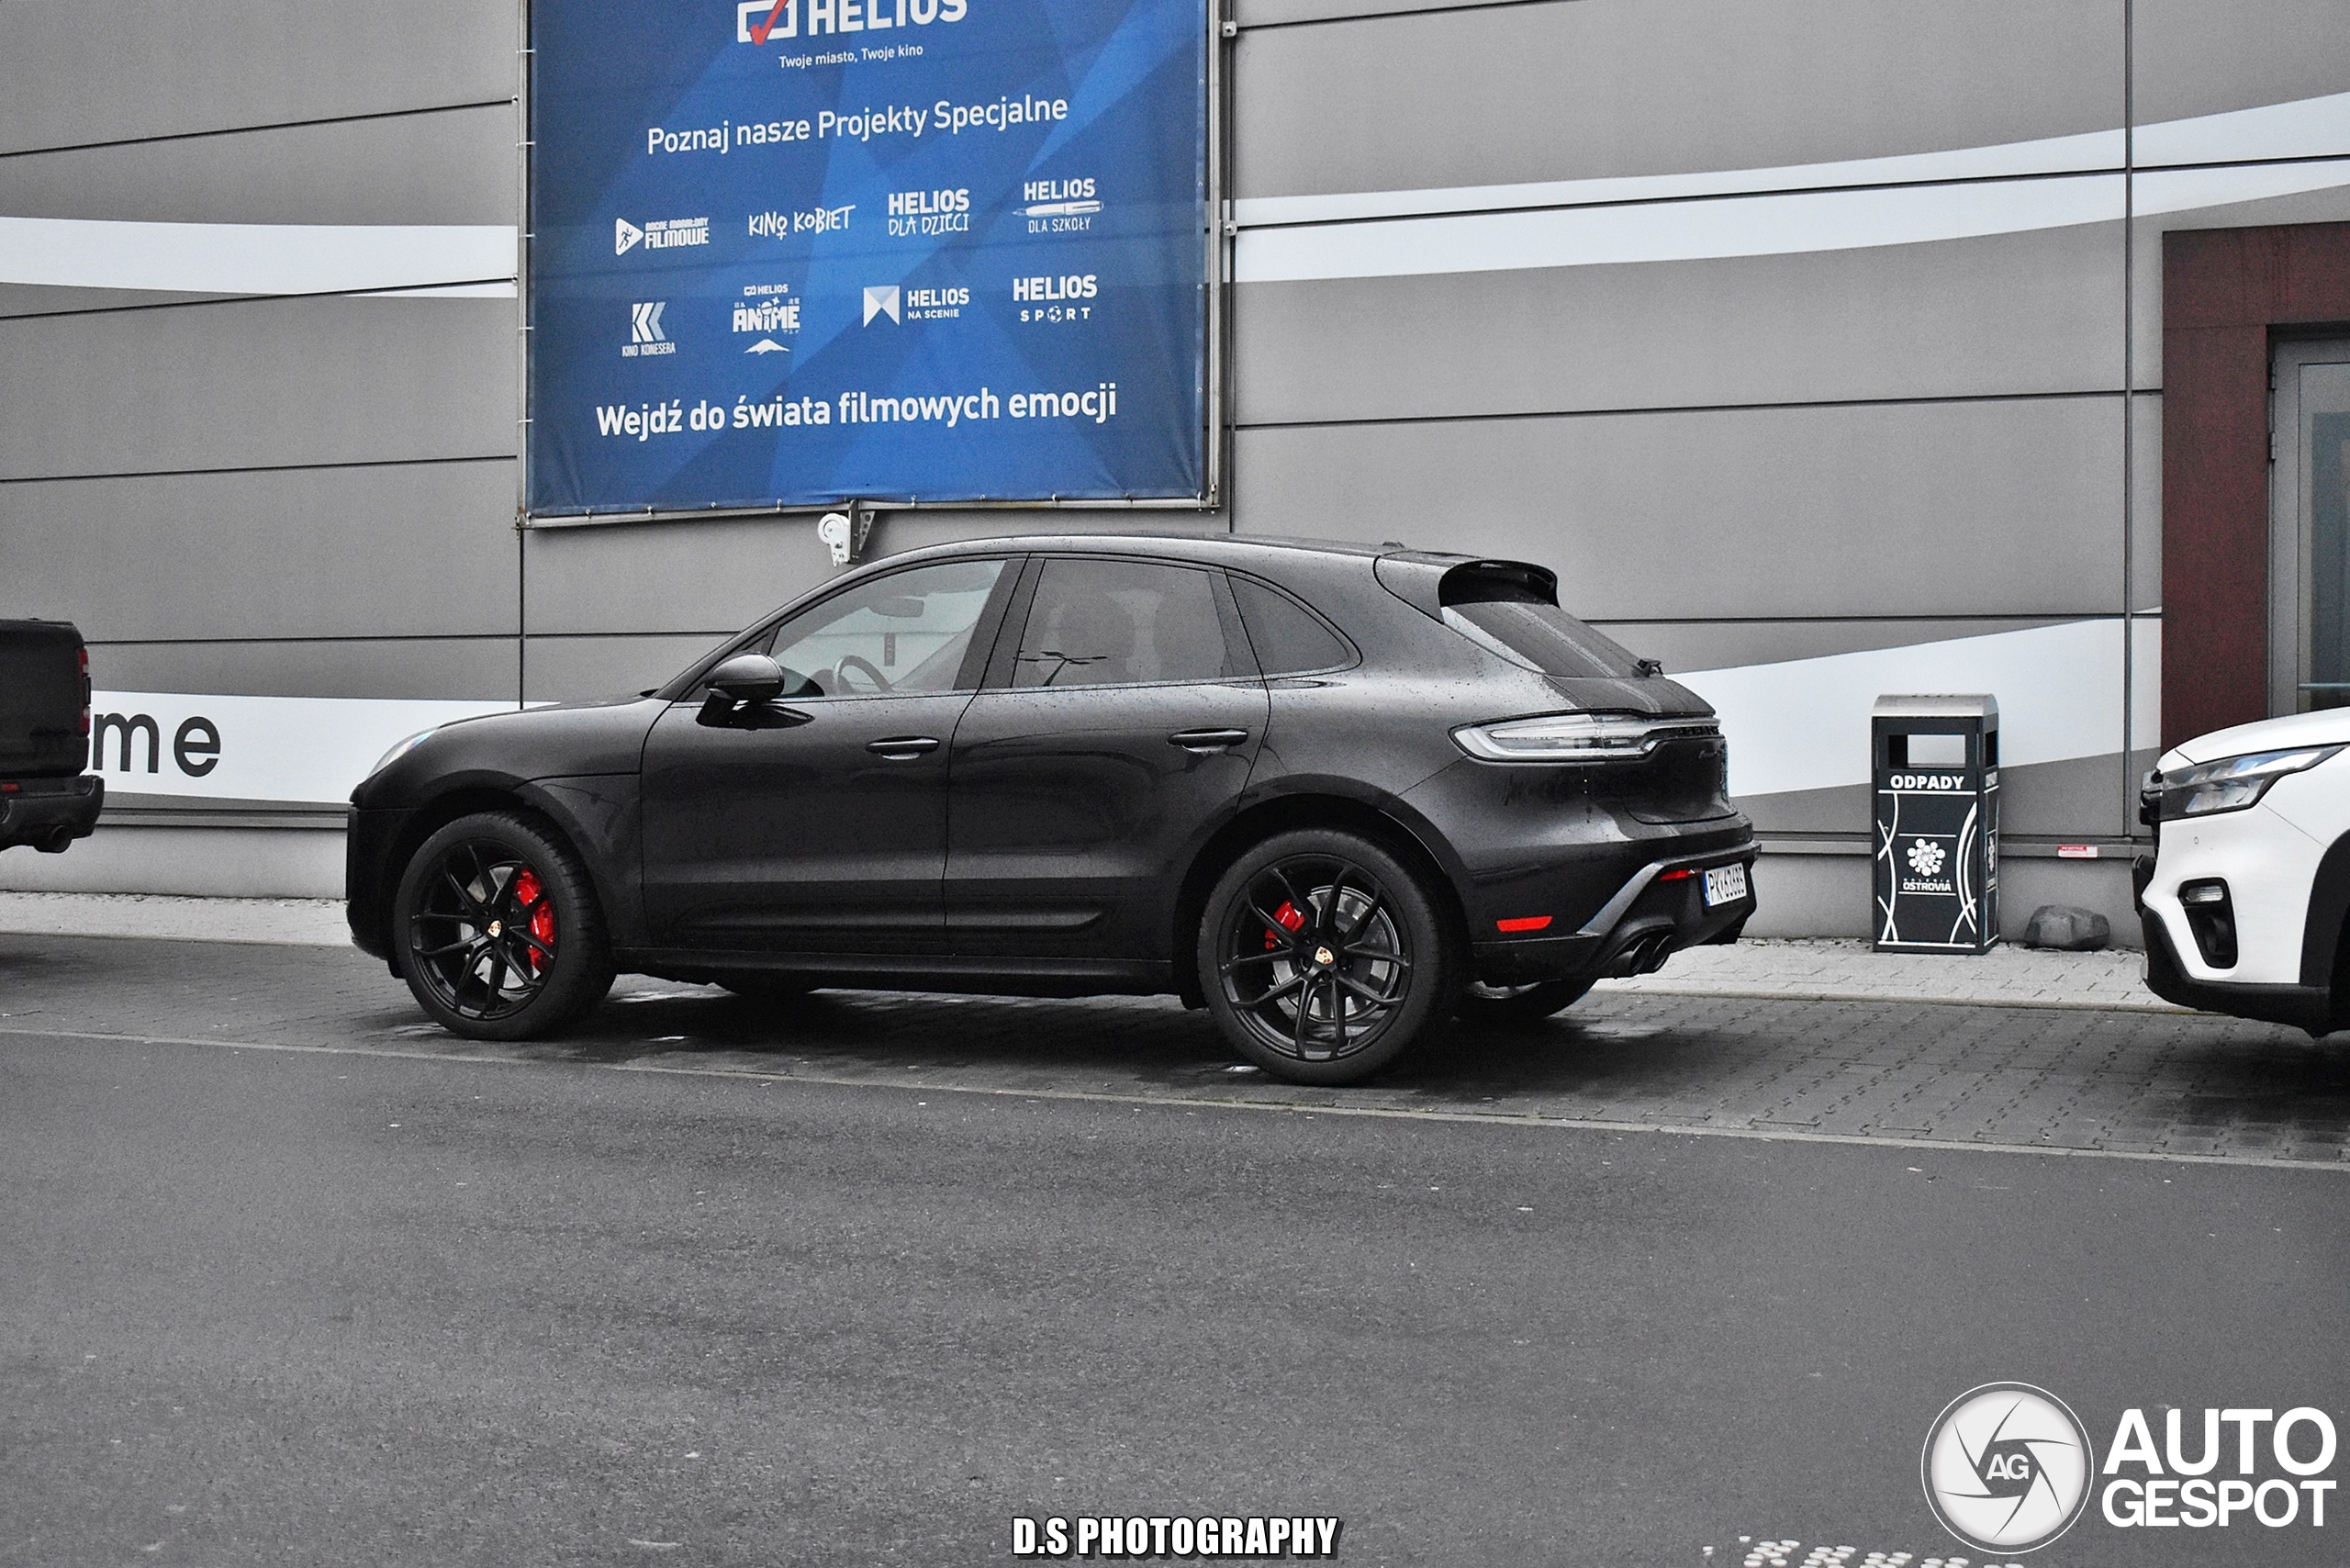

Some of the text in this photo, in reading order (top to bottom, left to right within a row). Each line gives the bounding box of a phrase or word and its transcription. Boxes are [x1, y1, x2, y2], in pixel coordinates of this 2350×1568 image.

[808, 0, 968, 36] HELIOS
[779, 44, 923, 69] Twoje miasto, Twoje kino
[647, 94, 1069, 154] Poznaj nasze Projekty Specjalne
[1024, 177, 1096, 201] HELIOS
[888, 188, 969, 216] HELIOS
[794, 205, 856, 234] KOBIET
[889, 212, 969, 237] DLA DZIECI
[1028, 217, 1091, 234] DLA SZKOŁY
[644, 227, 710, 250] FILMOWE
[757, 284, 789, 295] HELIOS
[907, 287, 970, 308] HELIOS
[1013, 274, 1099, 302] HELIOS
[733, 305, 800, 333] ANIME
[907, 308, 959, 319] NA SCENIE
[622, 344, 639, 357] KINO
[597, 383, 1117, 442] Wejdź do świata filmowych emocji
[1890, 775, 1964, 790] ODPADY
[1903, 881, 1952, 892] OSTROVIA
